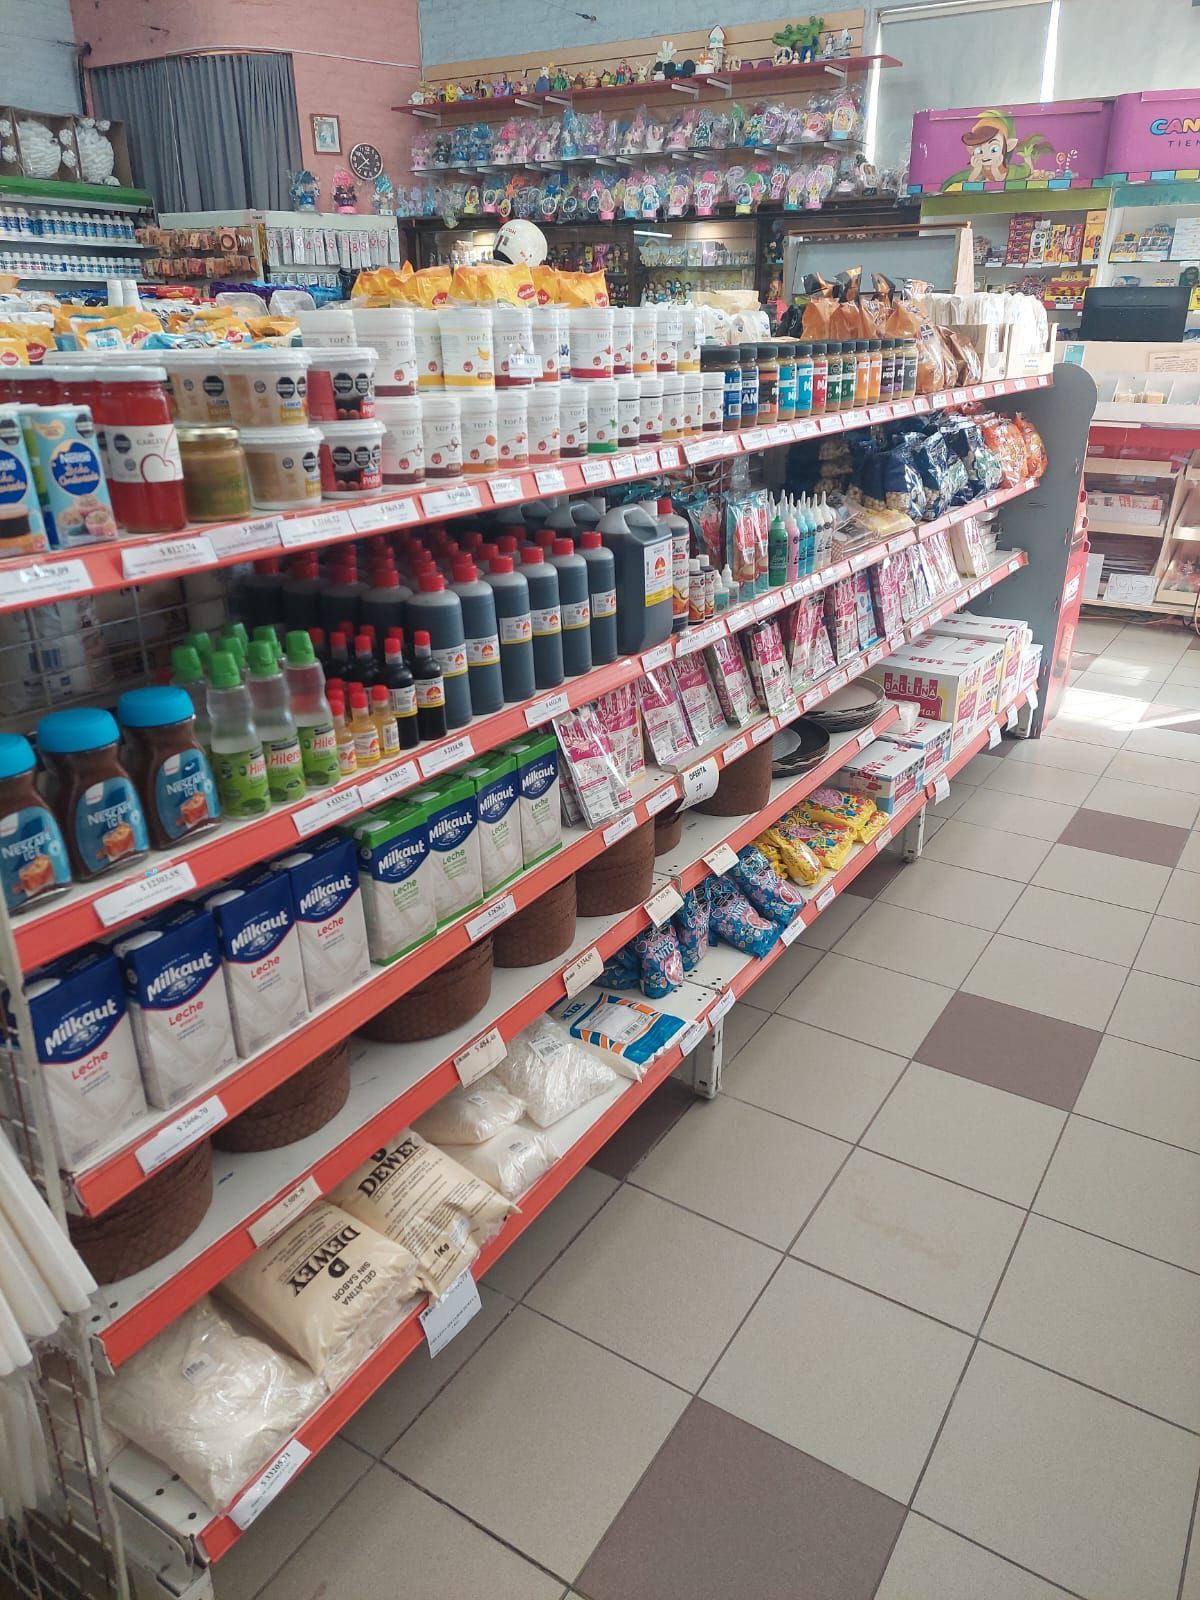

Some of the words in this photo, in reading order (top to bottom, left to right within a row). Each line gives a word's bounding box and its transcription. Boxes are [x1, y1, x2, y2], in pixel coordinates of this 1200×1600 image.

[883, 682, 937, 699] BALLINA
[521, 764, 555, 792] Milkaut
[688, 766, 707, 781] OFERTA
[183, 784, 199, 797] ICE
[479, 785, 514, 815] Milkaut
[531, 797, 549, 813] Leche
[106, 815, 124, 829] ICE
[428, 811, 473, 843] Milkaut
[491, 820, 508, 836] Leche
[22, 846, 41, 861] ICE
[378, 839, 425, 876] Milkaut
[442, 848, 466, 865] Leche
[298, 874, 353, 915] Milkaut
[392, 878, 417, 898] Leche
[231, 909, 289, 955] Milkaut
[316, 915, 345, 938] Leche
[146, 950, 213, 1002] Milkaut
[250, 954, 281, 979] Leche
[44, 997, 118, 1056] Milkaut
[168, 1000, 204, 1027] Leche
[71, 1049, 109, 1081] Leche
[357, 1137, 420, 1198] DEWEY
[286, 1224, 362, 1298] DEWEY
[356, 1260, 372, 1276] SIN
[331, 1272, 360, 1302] SABOR
[341, 1269, 378, 1307] GELATINA
